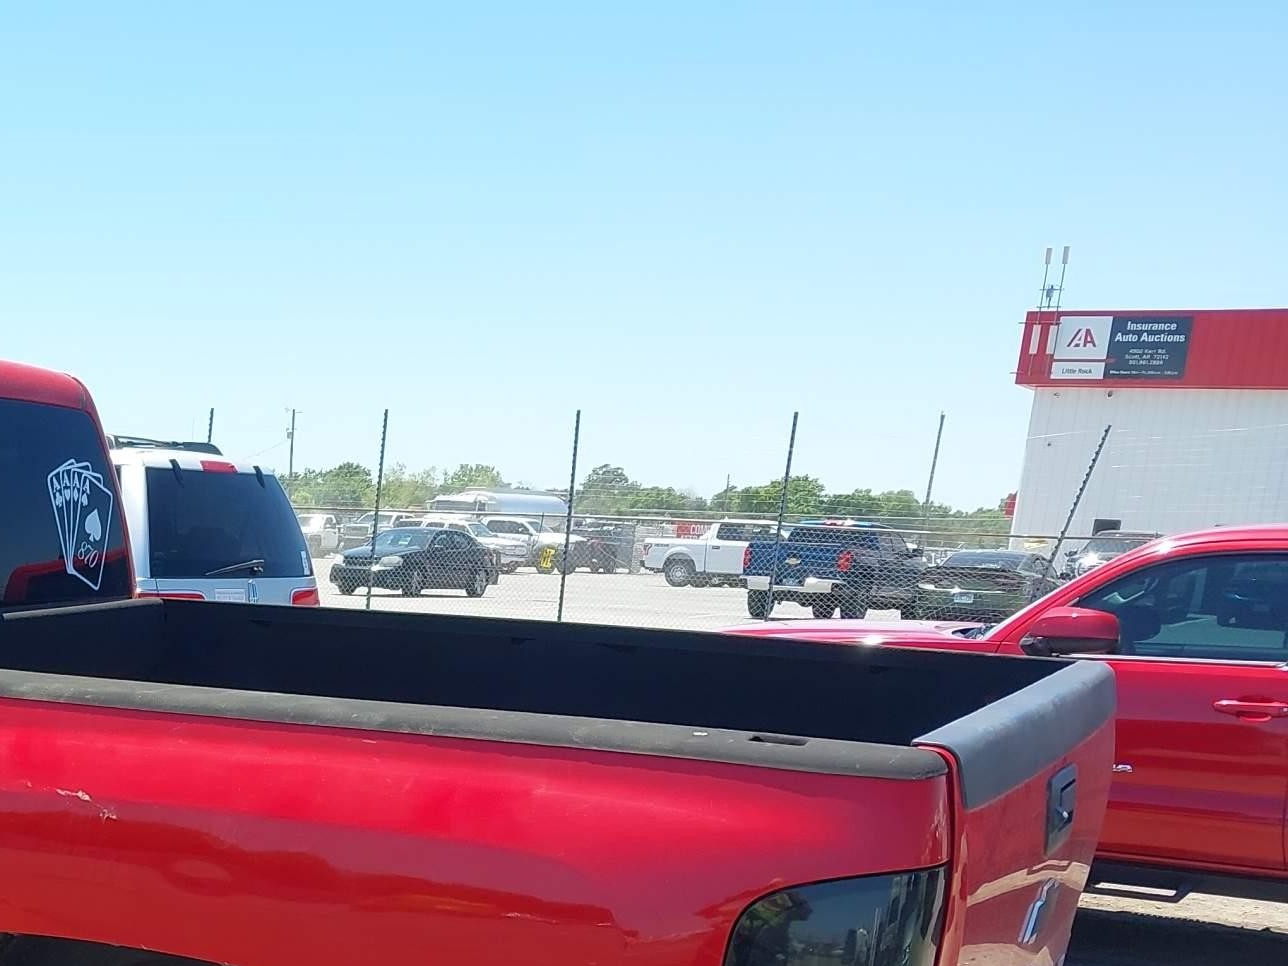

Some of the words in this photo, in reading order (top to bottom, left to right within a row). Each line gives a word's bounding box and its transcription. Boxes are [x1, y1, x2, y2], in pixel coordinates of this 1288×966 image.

[1126, 321, 1178, 331] Insurance
[1114, 333, 1139, 342] Auto
[1140, 332, 1186, 342] Auctions
[77, 541, 99, 568] 870
